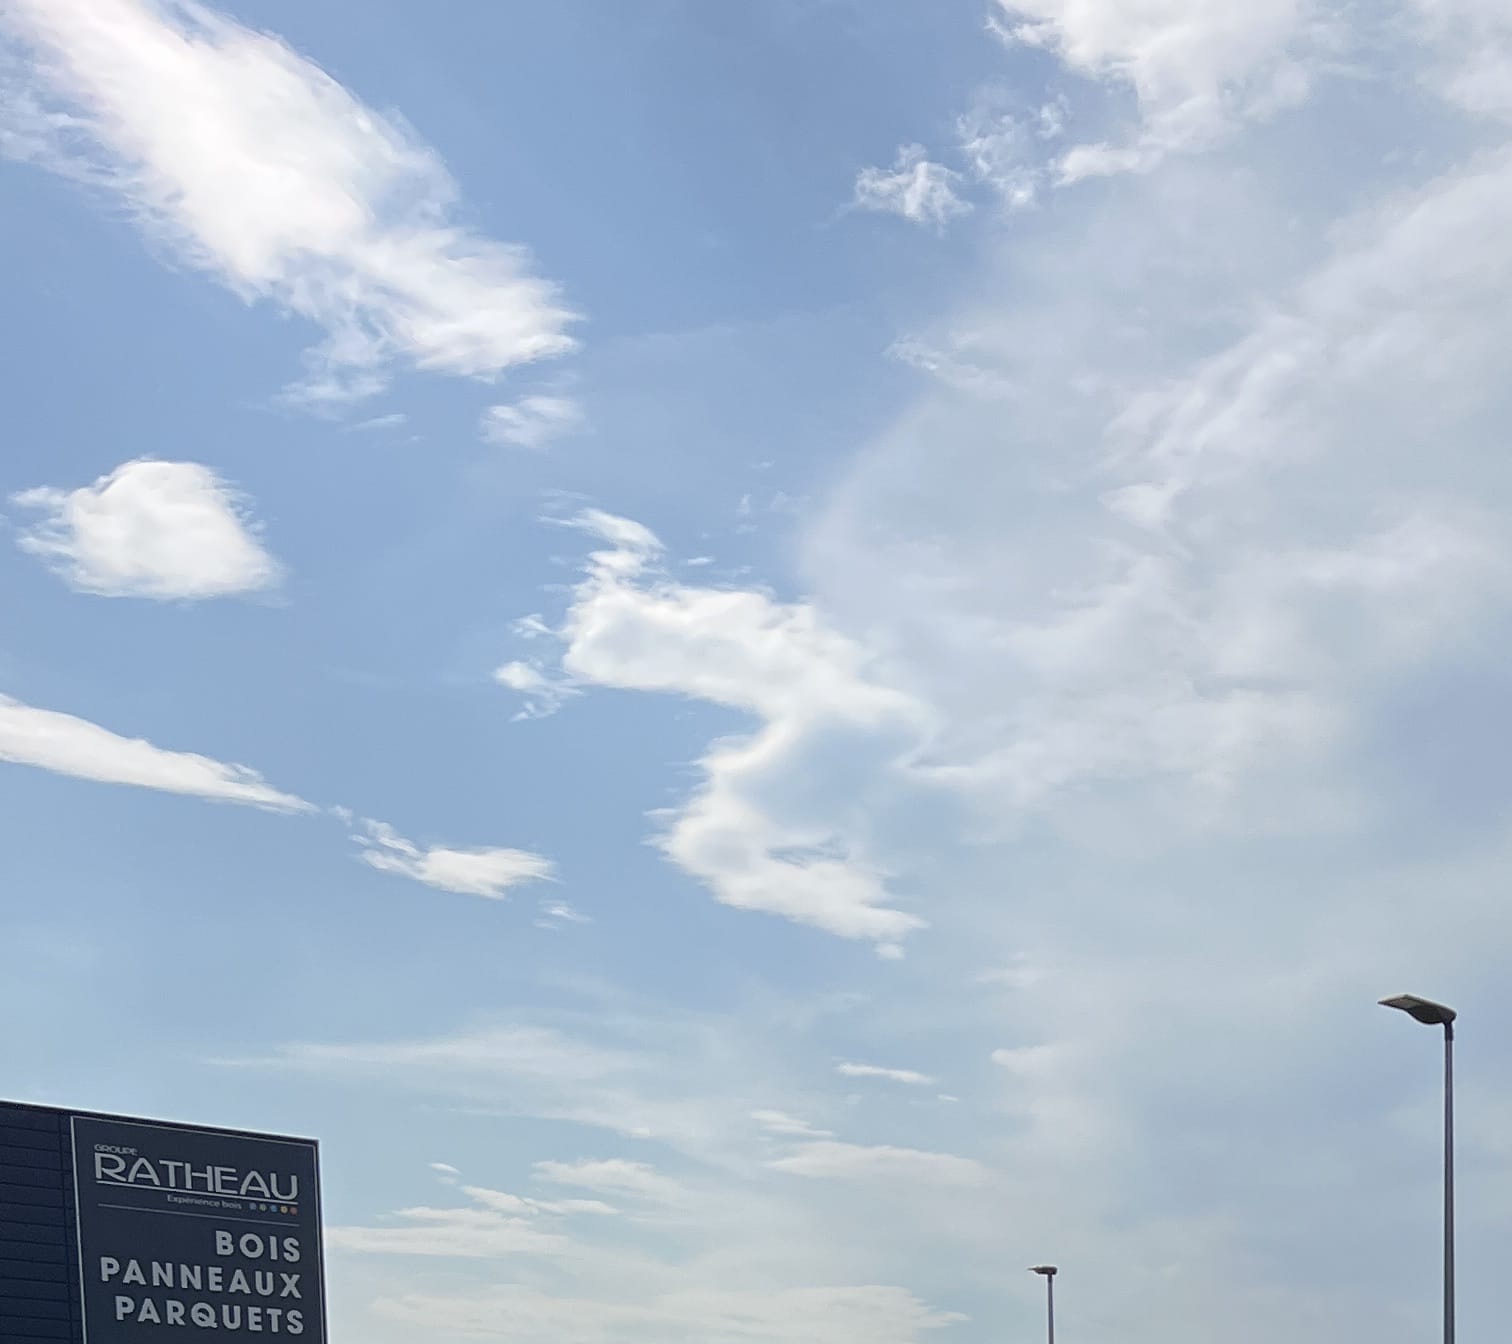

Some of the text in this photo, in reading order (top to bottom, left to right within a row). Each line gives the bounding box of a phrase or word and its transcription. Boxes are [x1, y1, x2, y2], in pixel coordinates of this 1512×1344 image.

[94, 1143, 138, 1156] GROUPE
[94, 1152, 298, 1200] RATHEAU
[215, 1230, 300, 1262] BOIS
[100, 1256, 302, 1298] PANNEAUX
[115, 1295, 304, 1334] PARQUETS
